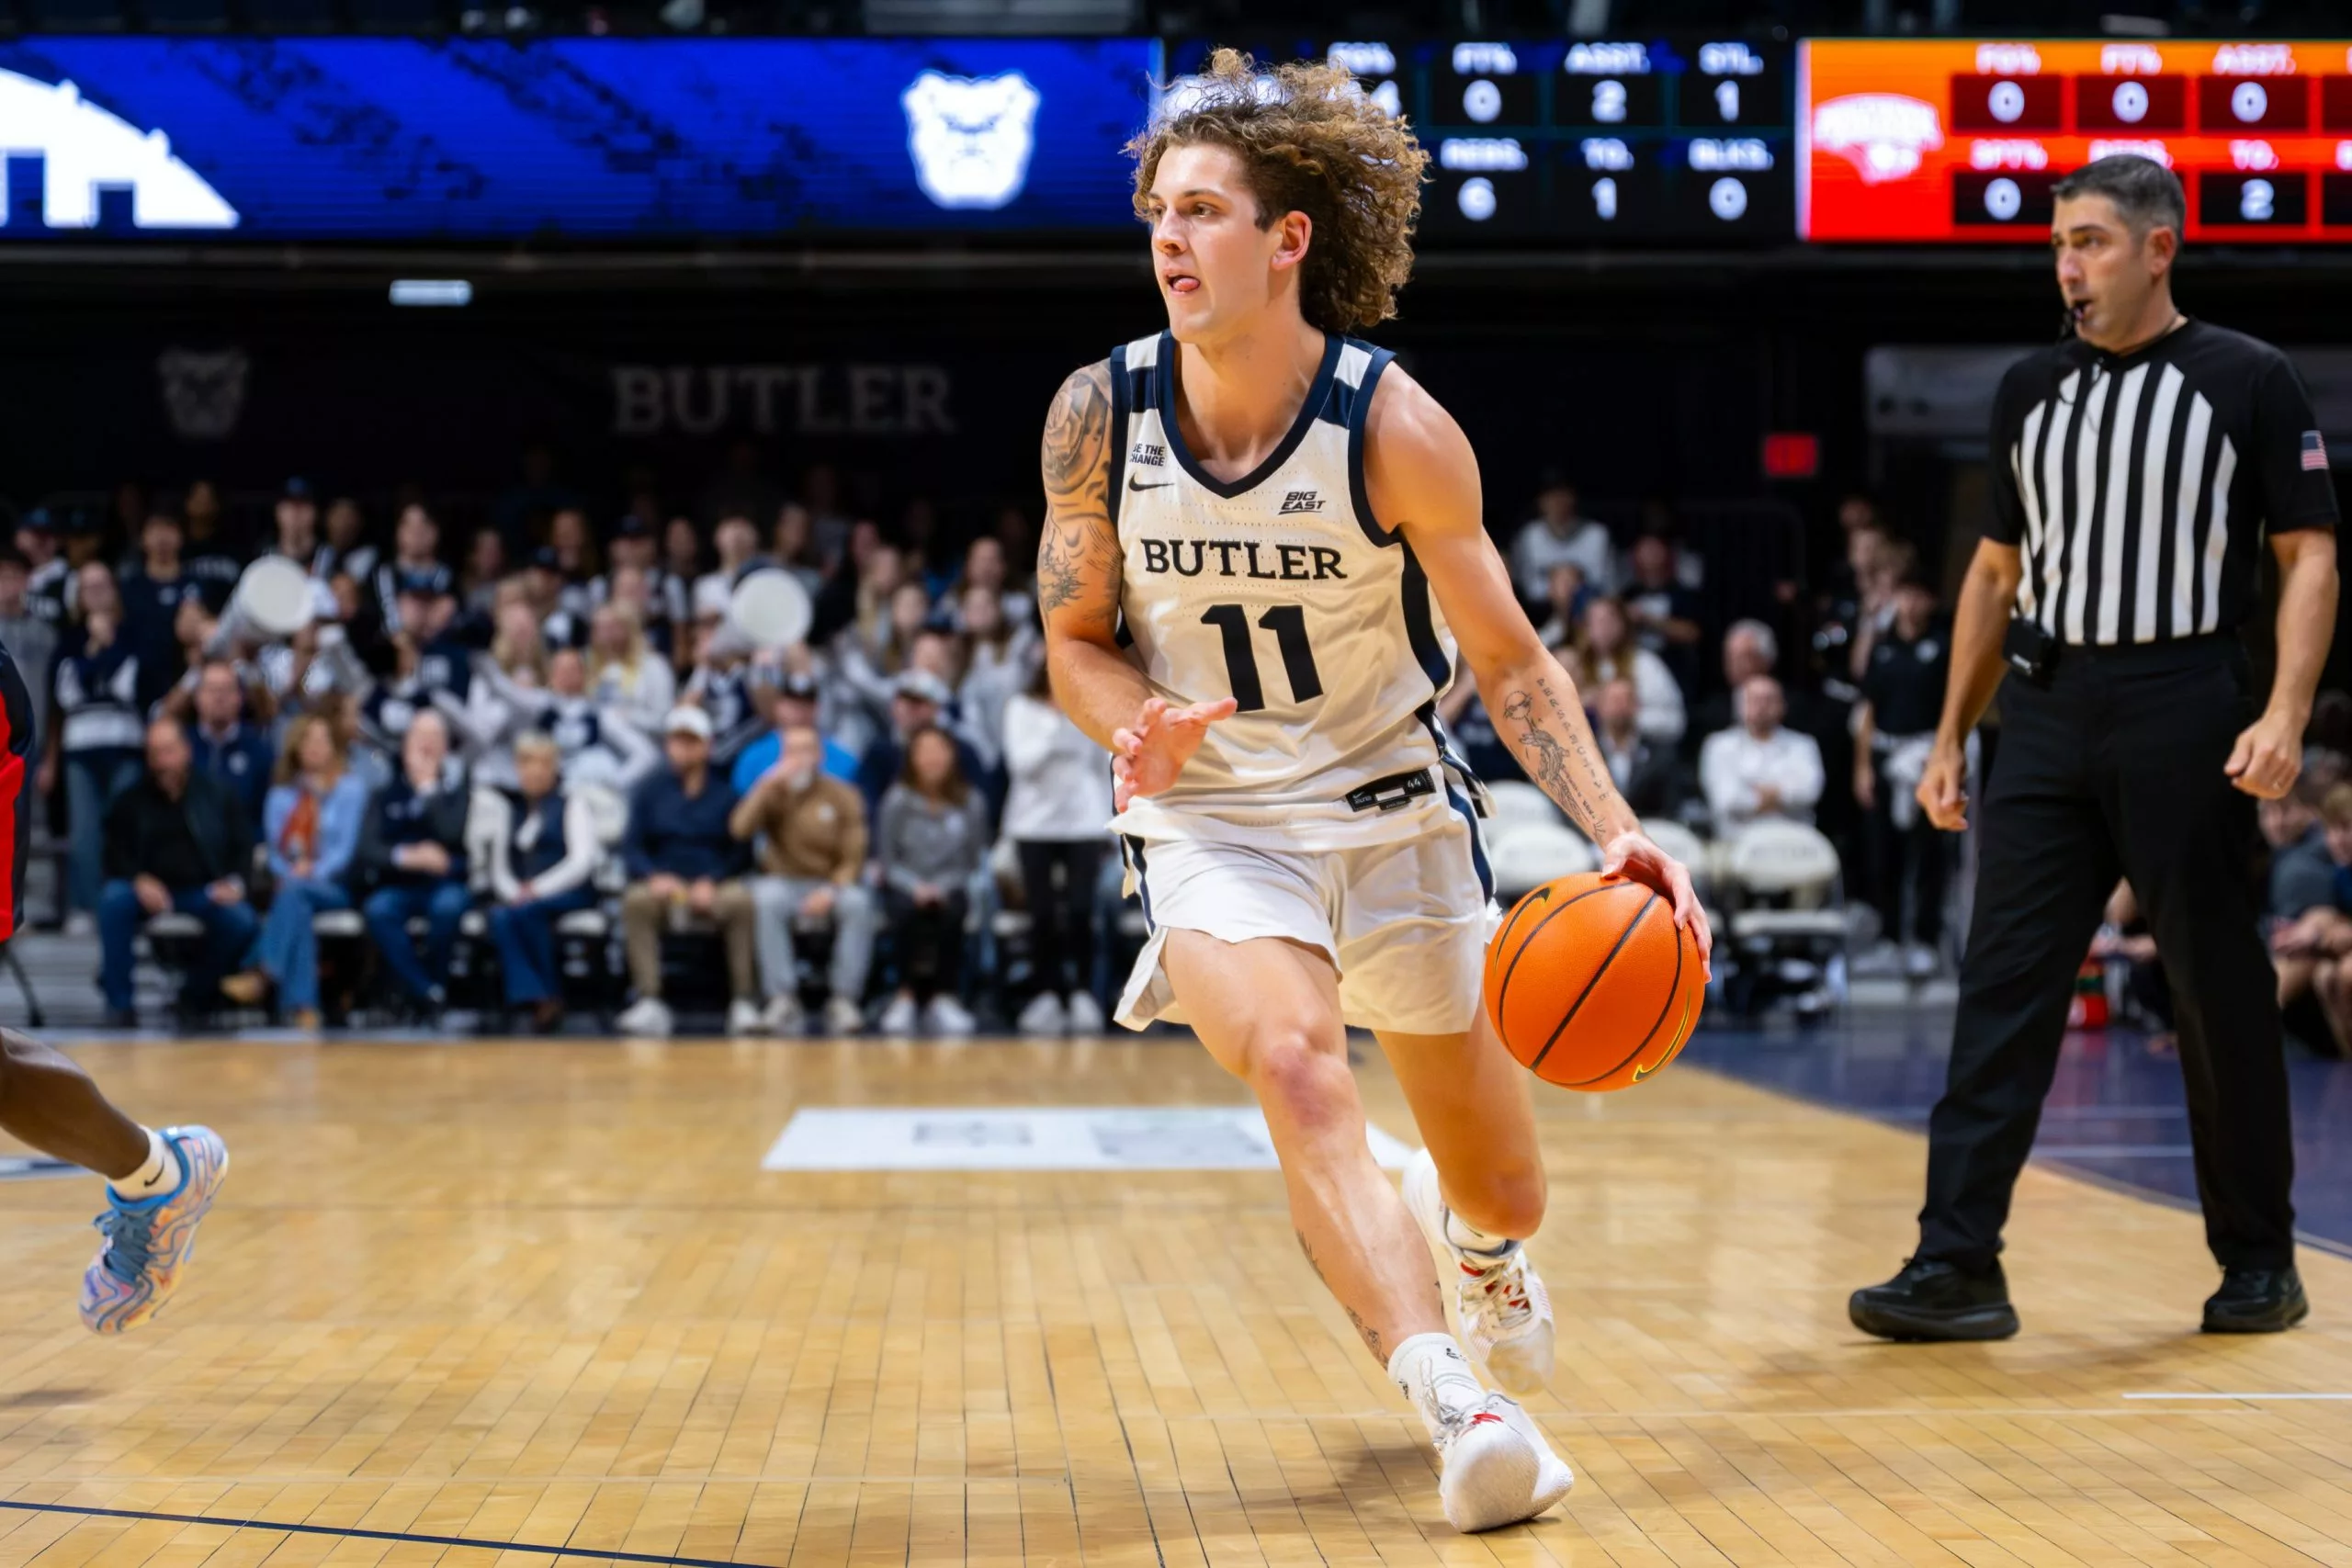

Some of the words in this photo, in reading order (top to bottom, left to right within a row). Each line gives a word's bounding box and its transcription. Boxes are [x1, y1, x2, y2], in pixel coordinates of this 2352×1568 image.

[1463, 80, 1501, 122] 0
[1592, 80, 1626, 122] 2
[1714, 80, 1739, 121] 1
[1988, 81, 2024, 122] 0
[2113, 81, 2148, 122] 0
[2232, 81, 2267, 122] 0
[1457, 177, 1496, 220] 6
[1592, 177, 1617, 220] 1
[1709, 177, 1747, 220] 0
[1984, 177, 2021, 220] 0
[2240, 178, 2274, 220] 2
[611, 367, 954, 434] BUTLER
[1145, 445, 1165, 456] THE
[1281, 500, 1326, 511] EAST
[1285, 491, 1317, 501] BIG
[1141, 538, 1347, 581] BUTLER
[1200, 604, 1324, 713] 11
